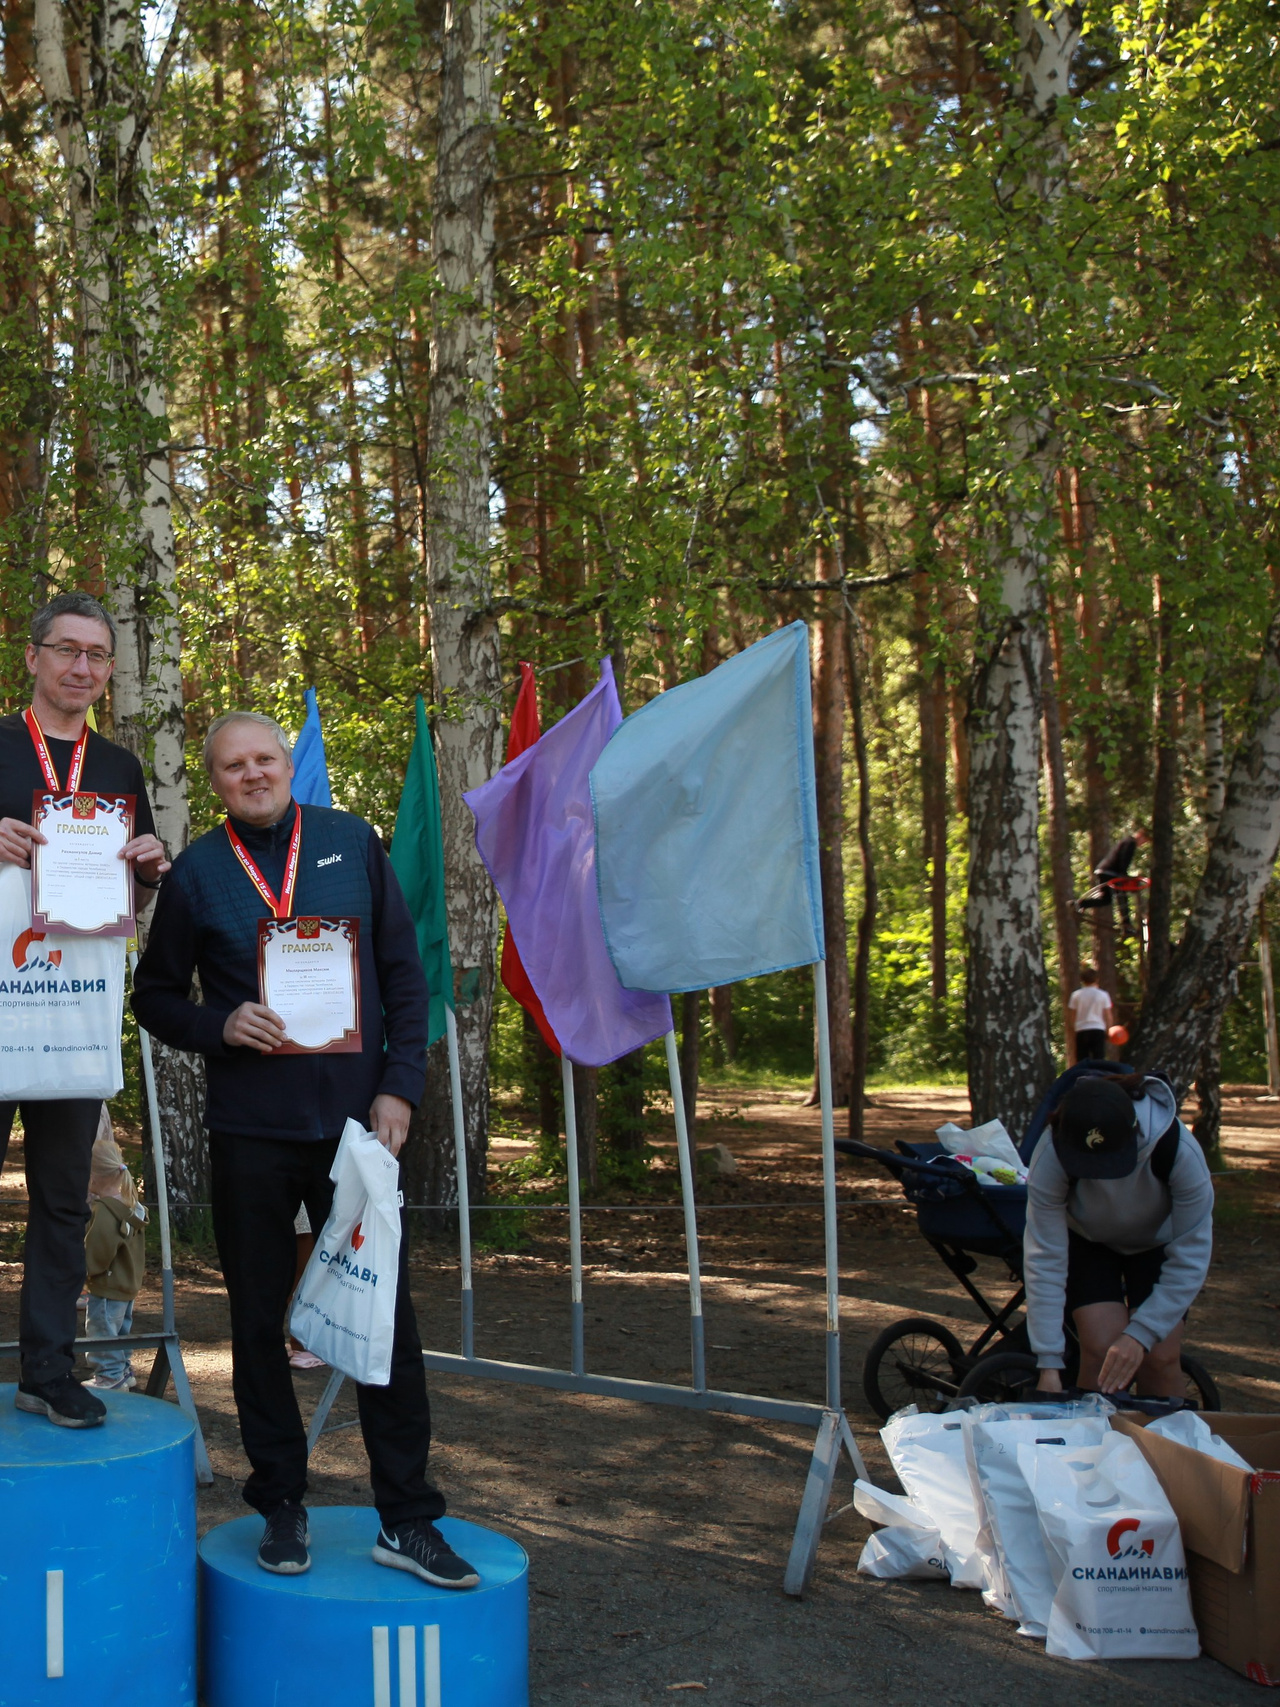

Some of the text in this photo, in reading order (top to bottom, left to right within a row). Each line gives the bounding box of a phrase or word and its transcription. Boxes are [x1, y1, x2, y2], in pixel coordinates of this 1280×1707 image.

[56, 824, 109, 835] ГРАМОТА
[235, 845, 245, 859] Иван
[248, 865, 260, 882] Марья
[263, 889, 271, 898] лет
[282, 943, 333, 953] ГРАМОТА
[51, 1044, 108, 1052] skandinavia74.ru
[1098, 1585, 1140, 1593] спортивный
